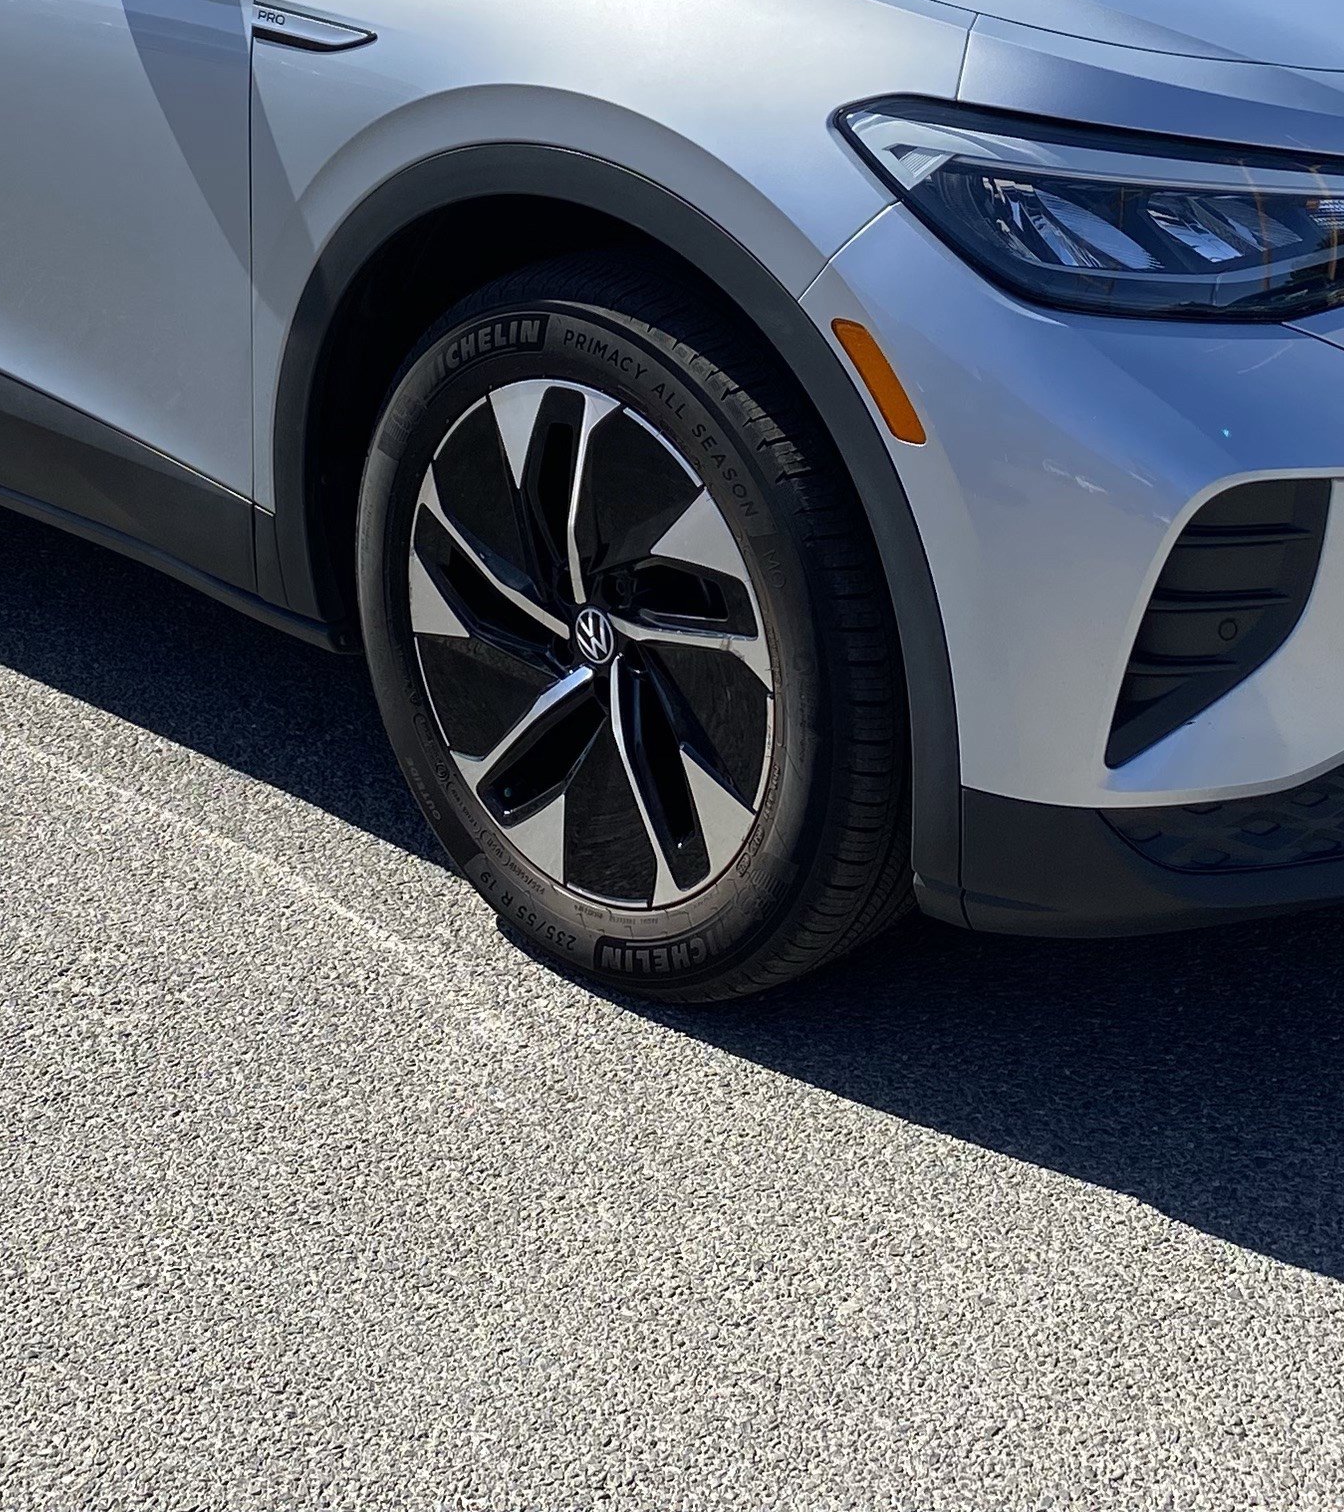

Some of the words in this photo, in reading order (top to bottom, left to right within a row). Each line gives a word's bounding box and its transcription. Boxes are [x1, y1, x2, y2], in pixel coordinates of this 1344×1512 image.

[257, 9, 285, 25] PRO
[563, 329, 648, 380] PRIMACY
[651, 382, 688, 419] ALL
[691, 423, 759, 518] SEASON
[575, 608, 613, 662] VW
[479, 871, 498, 890] 19
[500, 892, 513, 907] R
[516, 905, 577, 951] 235/55
